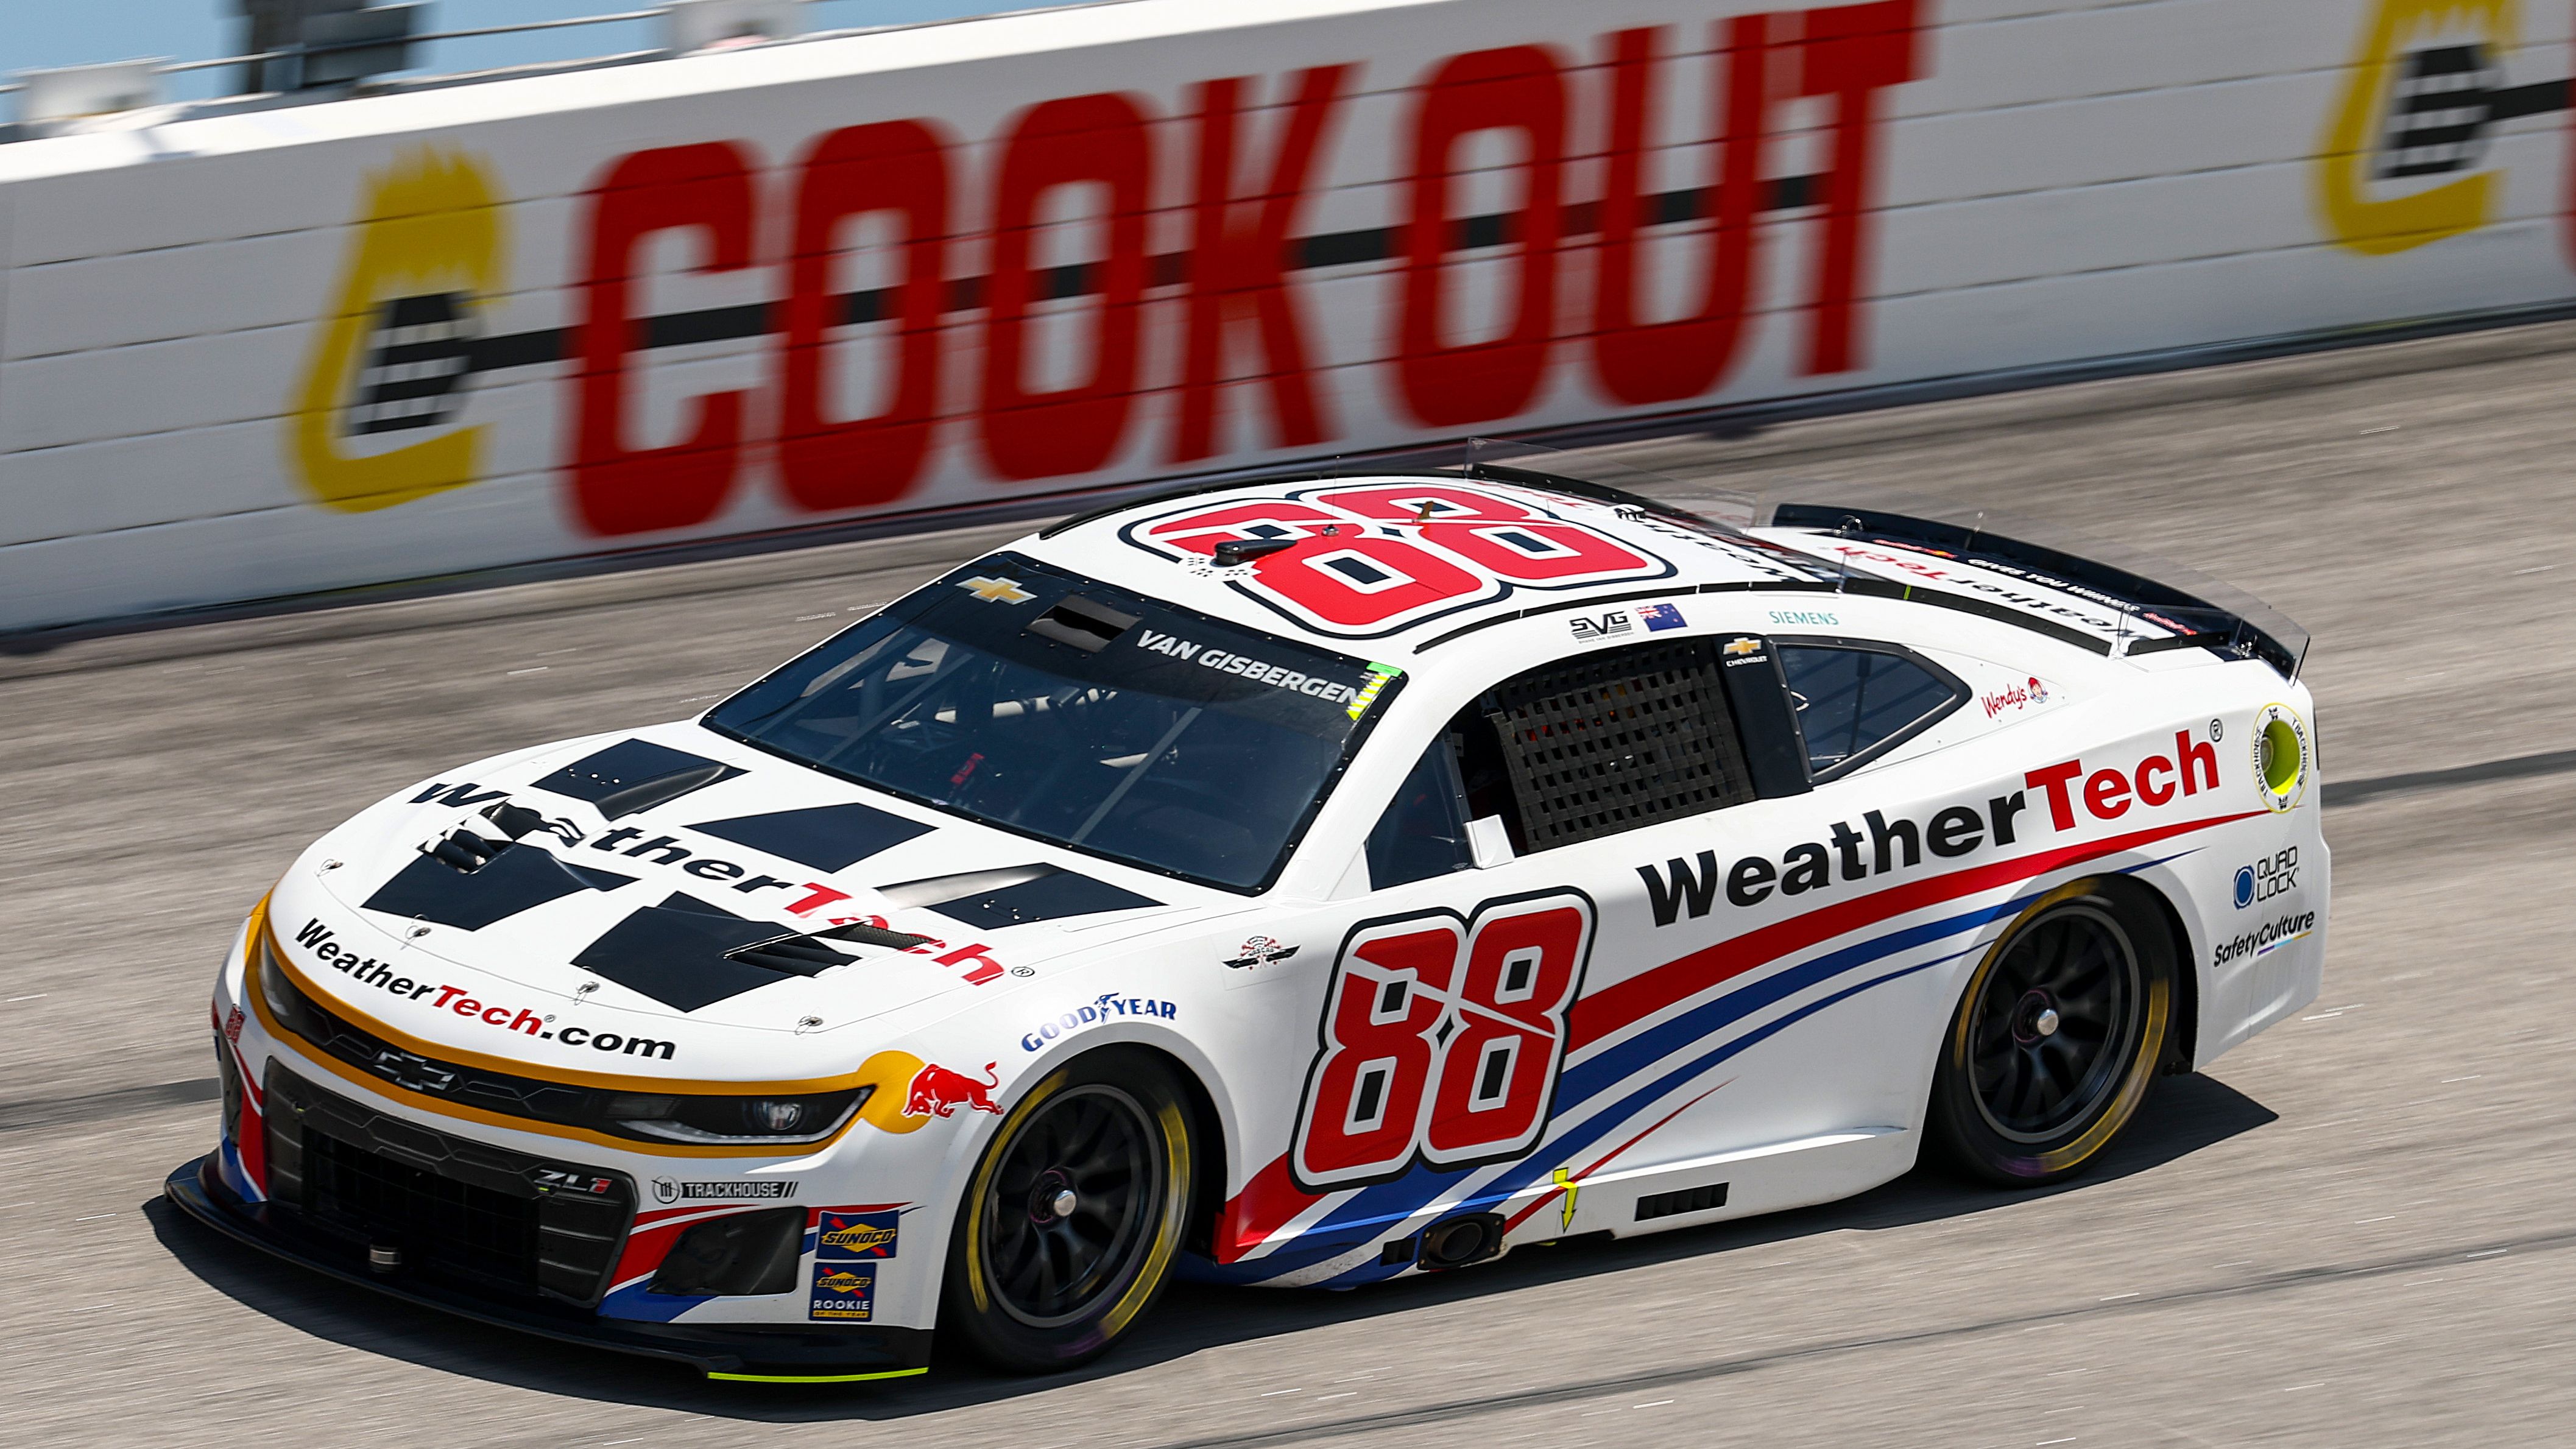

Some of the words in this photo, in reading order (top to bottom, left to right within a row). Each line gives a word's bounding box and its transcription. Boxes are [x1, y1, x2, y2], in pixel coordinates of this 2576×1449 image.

[1123, 484, 1672, 636] 88
[2027, 574, 2067, 587] YOU
[1570, 611, 1628, 634] SVG
[1770, 611, 1838, 625] SIEMENS
[1136, 629, 1202, 660] VAN
[1198, 649, 1360, 704] GISBERGEN
[1981, 683, 2027, 718] Wendy's
[2257, 846, 2297, 880] QUAD
[2257, 867, 2297, 902] LOCK
[2214, 911, 2315, 967] SafetyCulture
[1290, 888, 1595, 1192] 88
[534, 1169, 612, 1194] ZL1
[686, 1182, 782, 1198] TRACKHOUSE
[824, 1230, 894, 1244] SUNOCO
[819, 1278, 869, 1287] SUNOCO
[813, 1300, 870, 1310] ROOKIE
